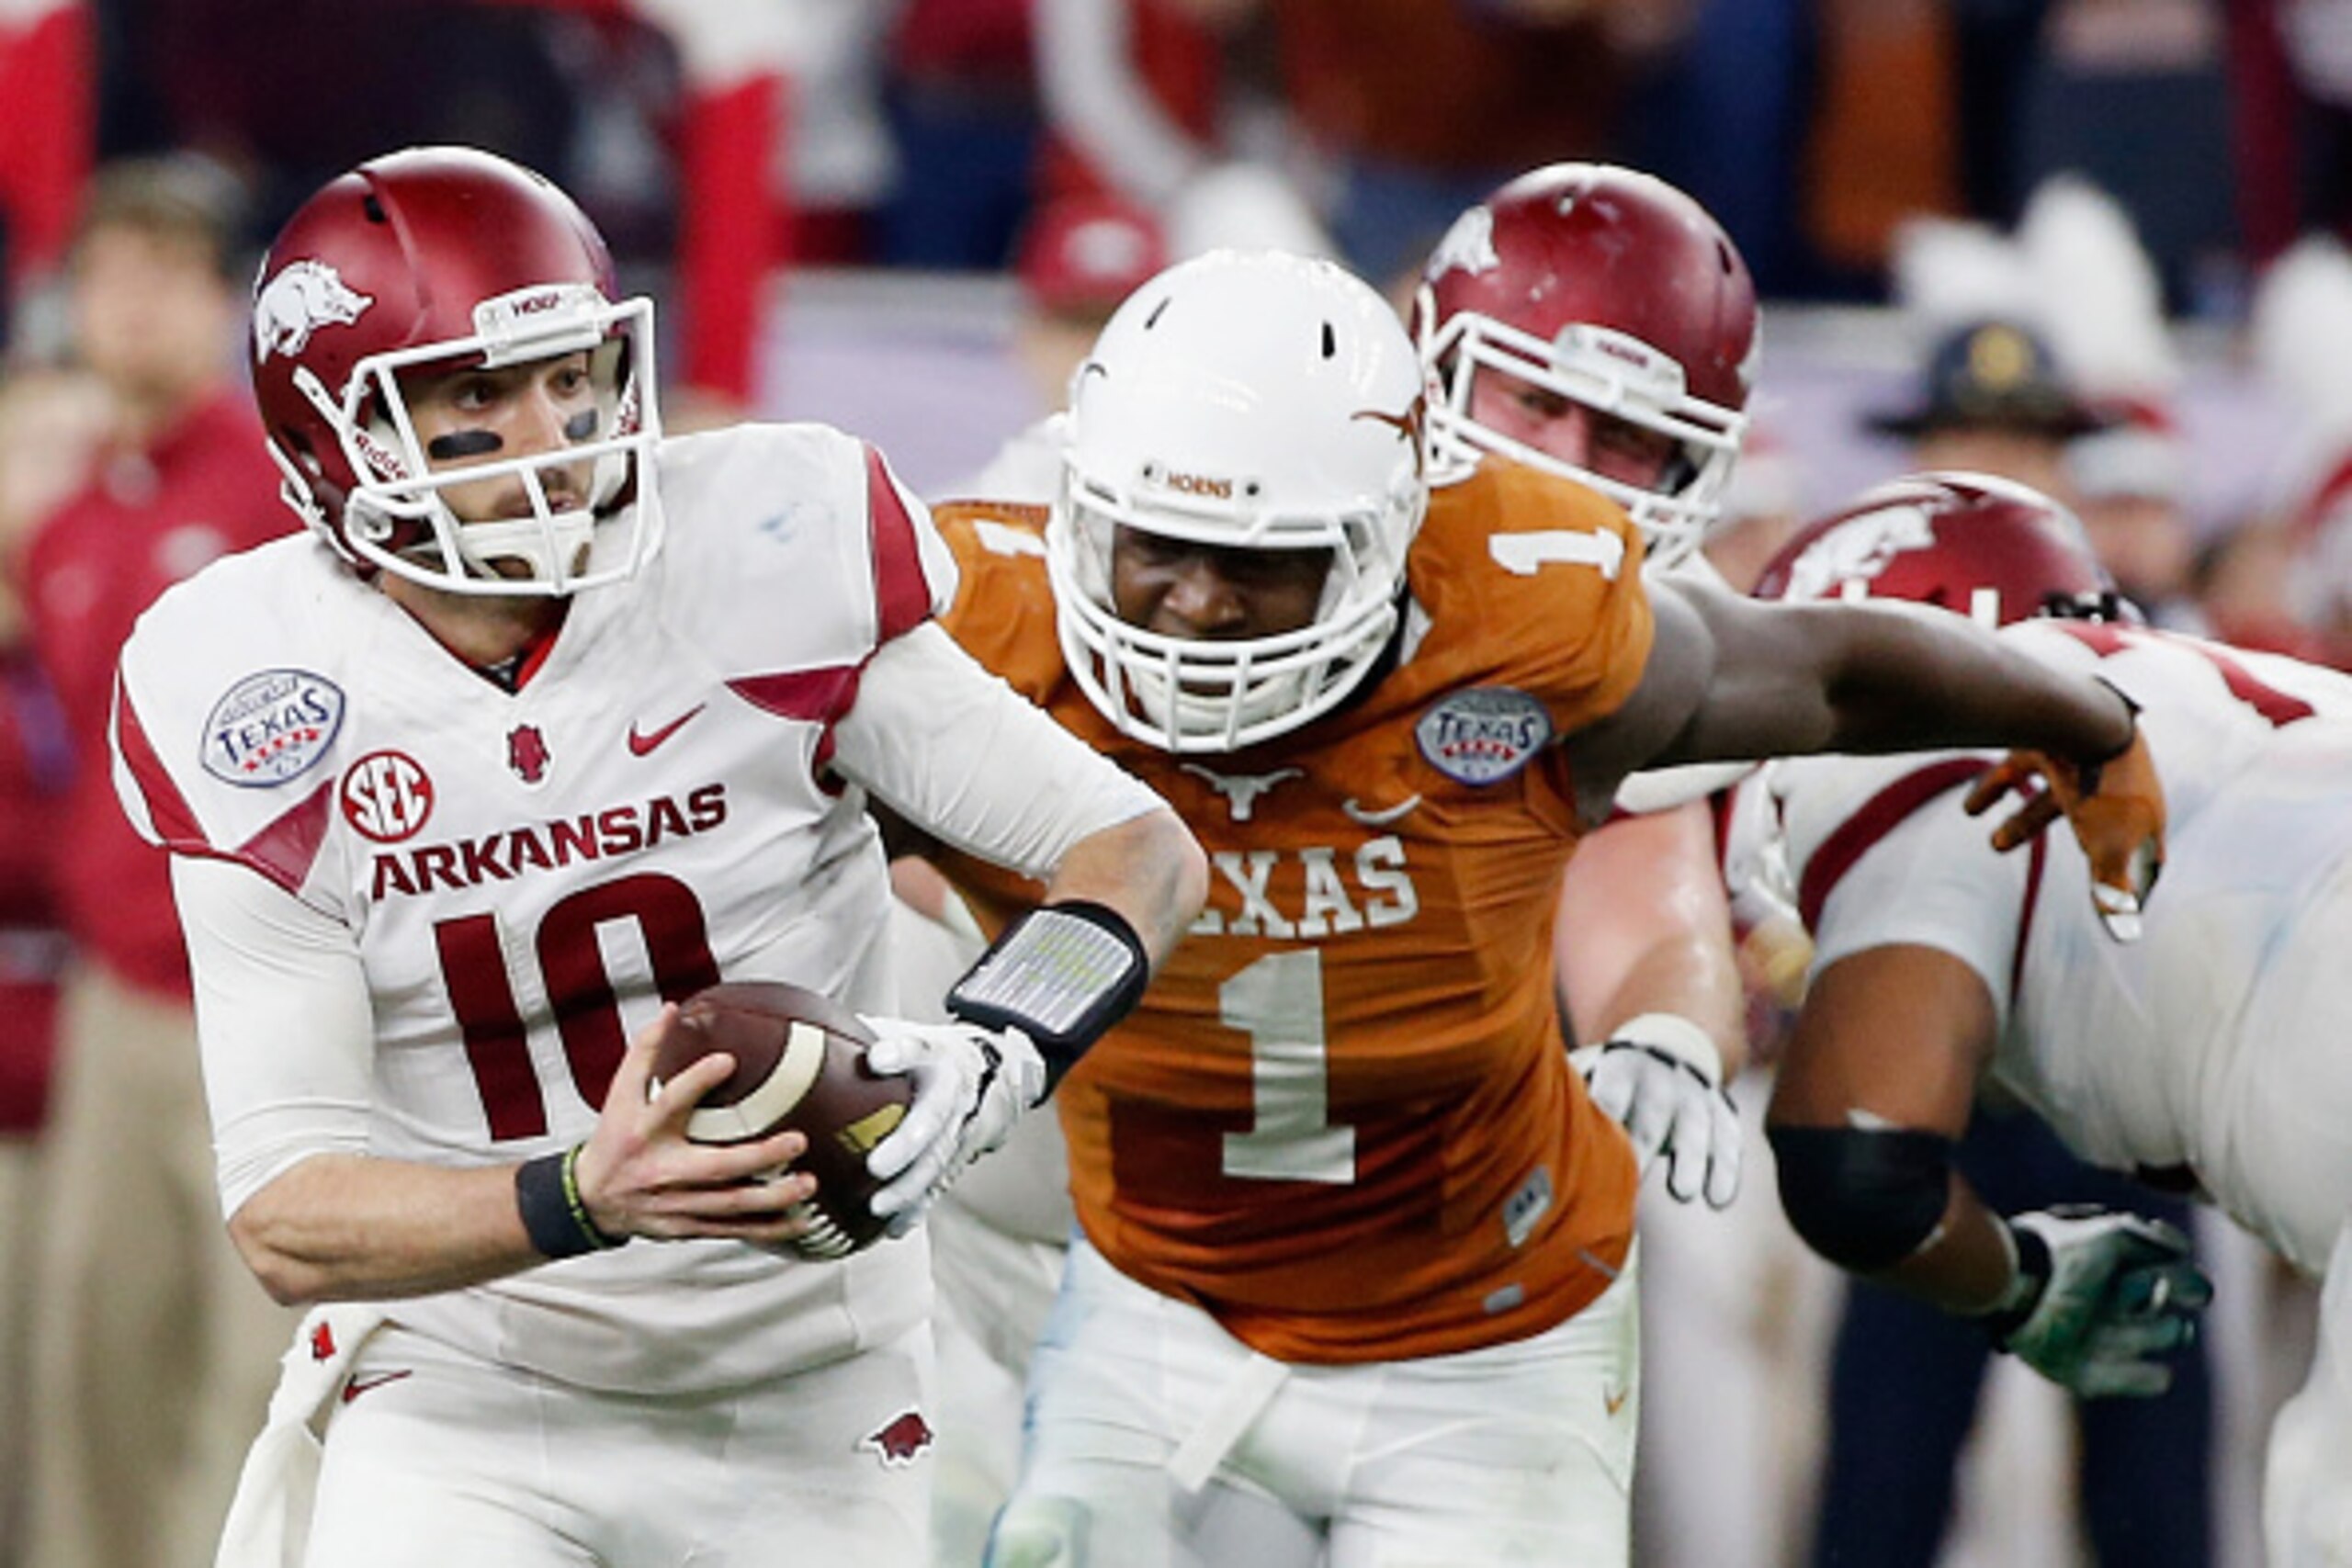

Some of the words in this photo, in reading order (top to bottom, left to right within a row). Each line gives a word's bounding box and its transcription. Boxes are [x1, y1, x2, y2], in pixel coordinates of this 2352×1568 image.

[1169, 471, 1232, 500] HORNS
[1487, 526, 1624, 581] 1
[217, 687, 330, 764] TEXAS
[1438, 712, 1538, 750] TEXAS
[345, 754, 428, 836] SEC
[371, 783, 727, 901] ARKANSAS
[1188, 835, 1419, 939] XAS
[433, 872, 722, 1142] 10
[1219, 947, 1356, 1185] 1
